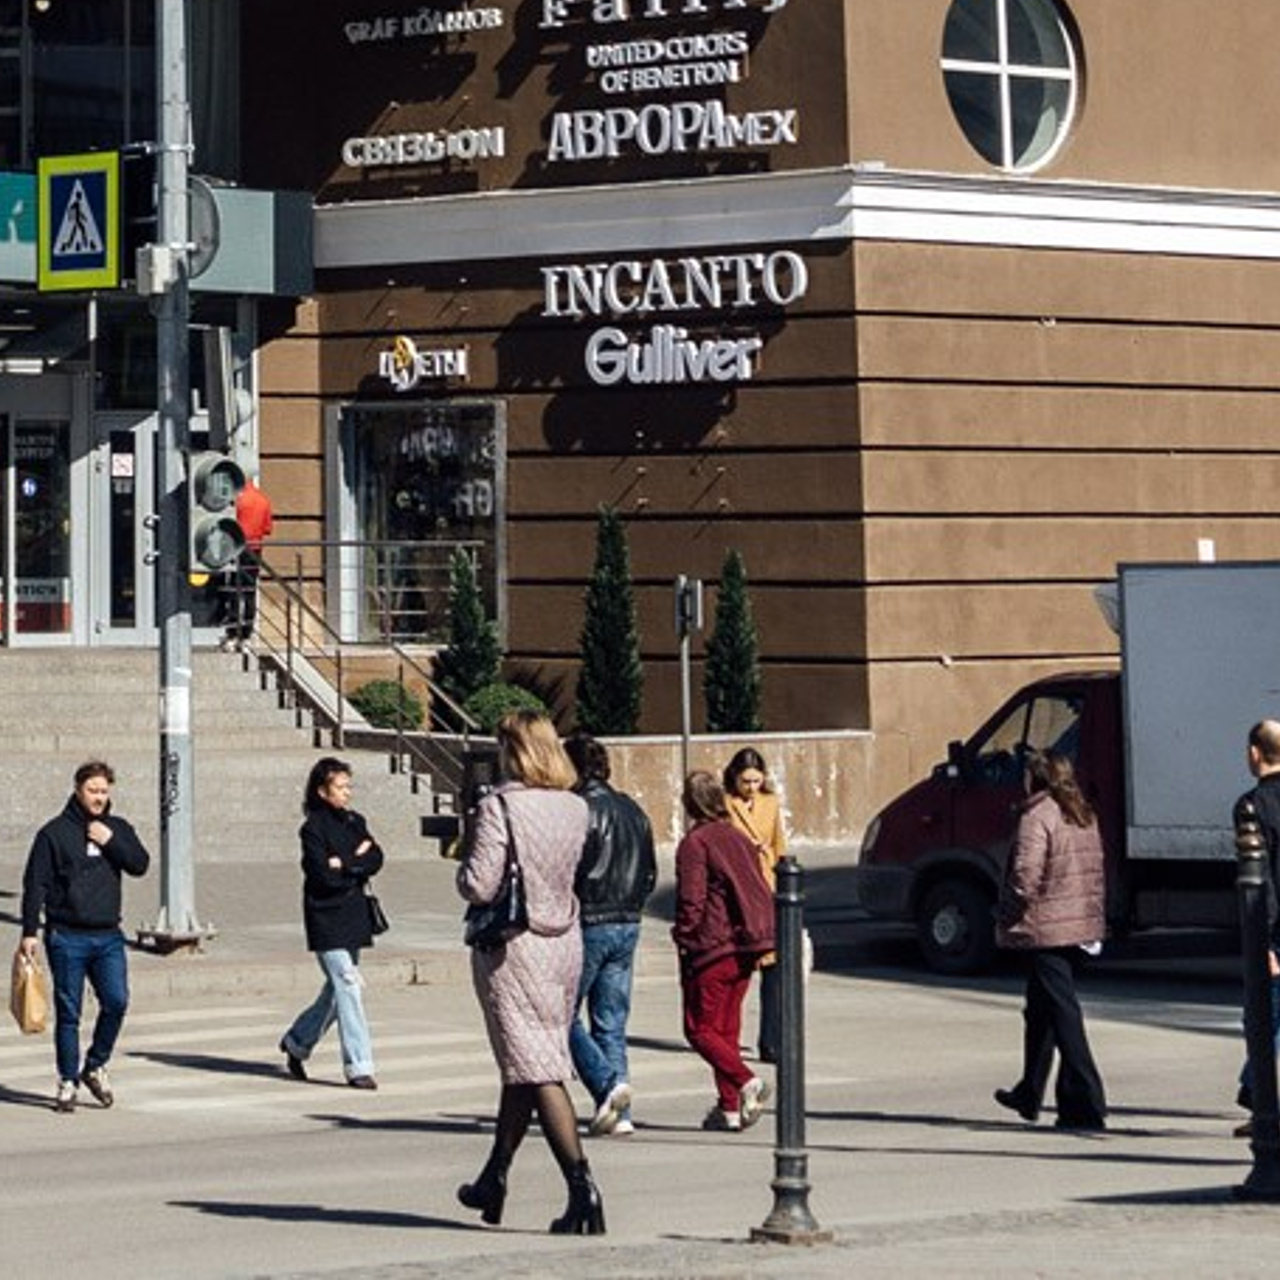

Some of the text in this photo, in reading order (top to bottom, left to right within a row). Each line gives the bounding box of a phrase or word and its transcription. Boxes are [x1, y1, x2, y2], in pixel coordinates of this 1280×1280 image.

[586, 30, 749, 69] UNITED COLORS
[601, 58, 741, 94] OF BENETTON
[539, 250, 809, 317] INCANTO
[584, 324, 763, 385] Gulliver
